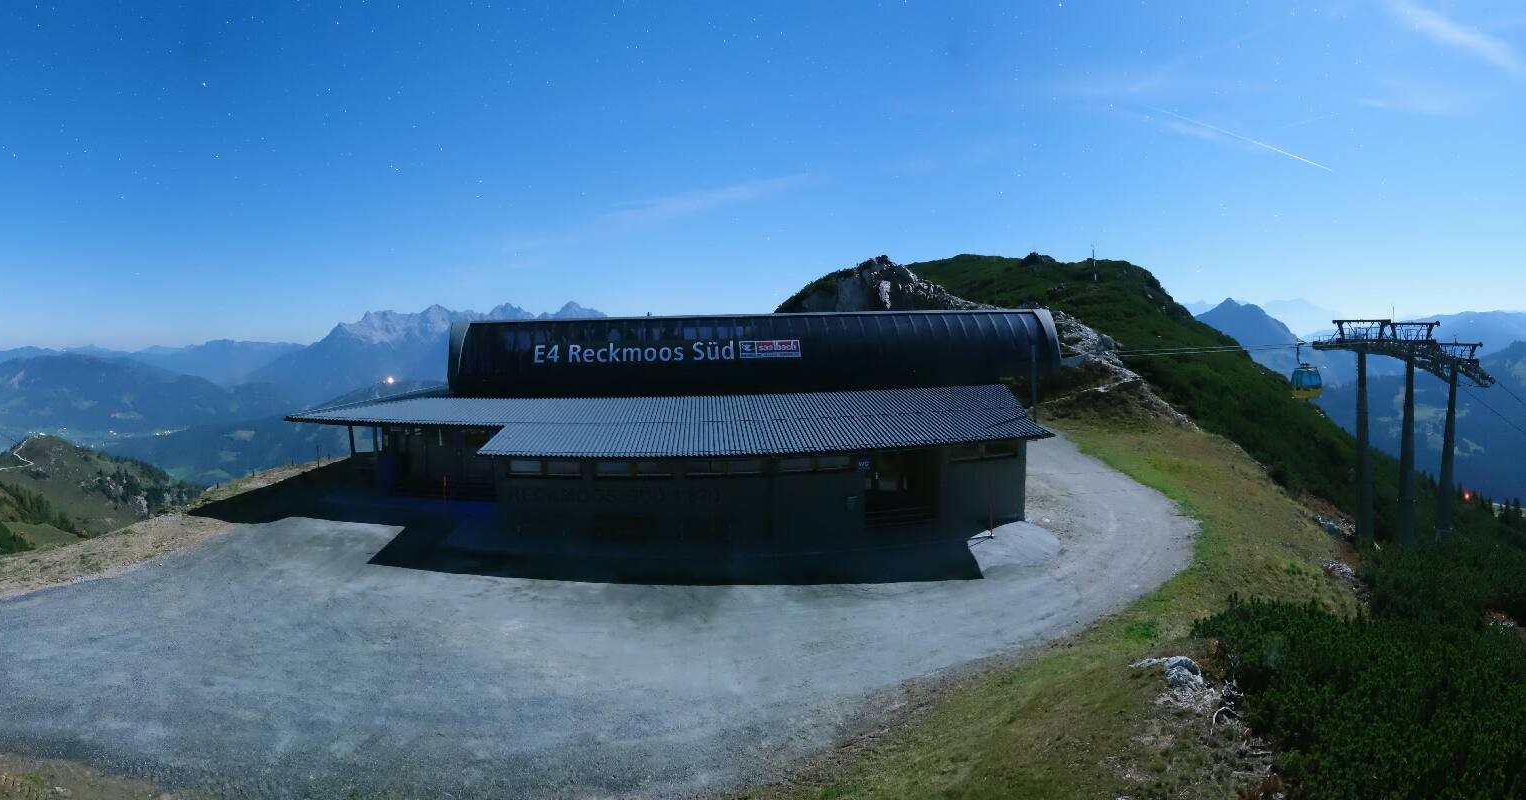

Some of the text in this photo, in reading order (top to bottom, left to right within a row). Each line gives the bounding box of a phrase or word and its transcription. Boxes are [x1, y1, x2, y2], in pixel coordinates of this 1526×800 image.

[533, 340, 735, 363] E4 Reckmoos Süd
[758, 340, 797, 351] saalbach
